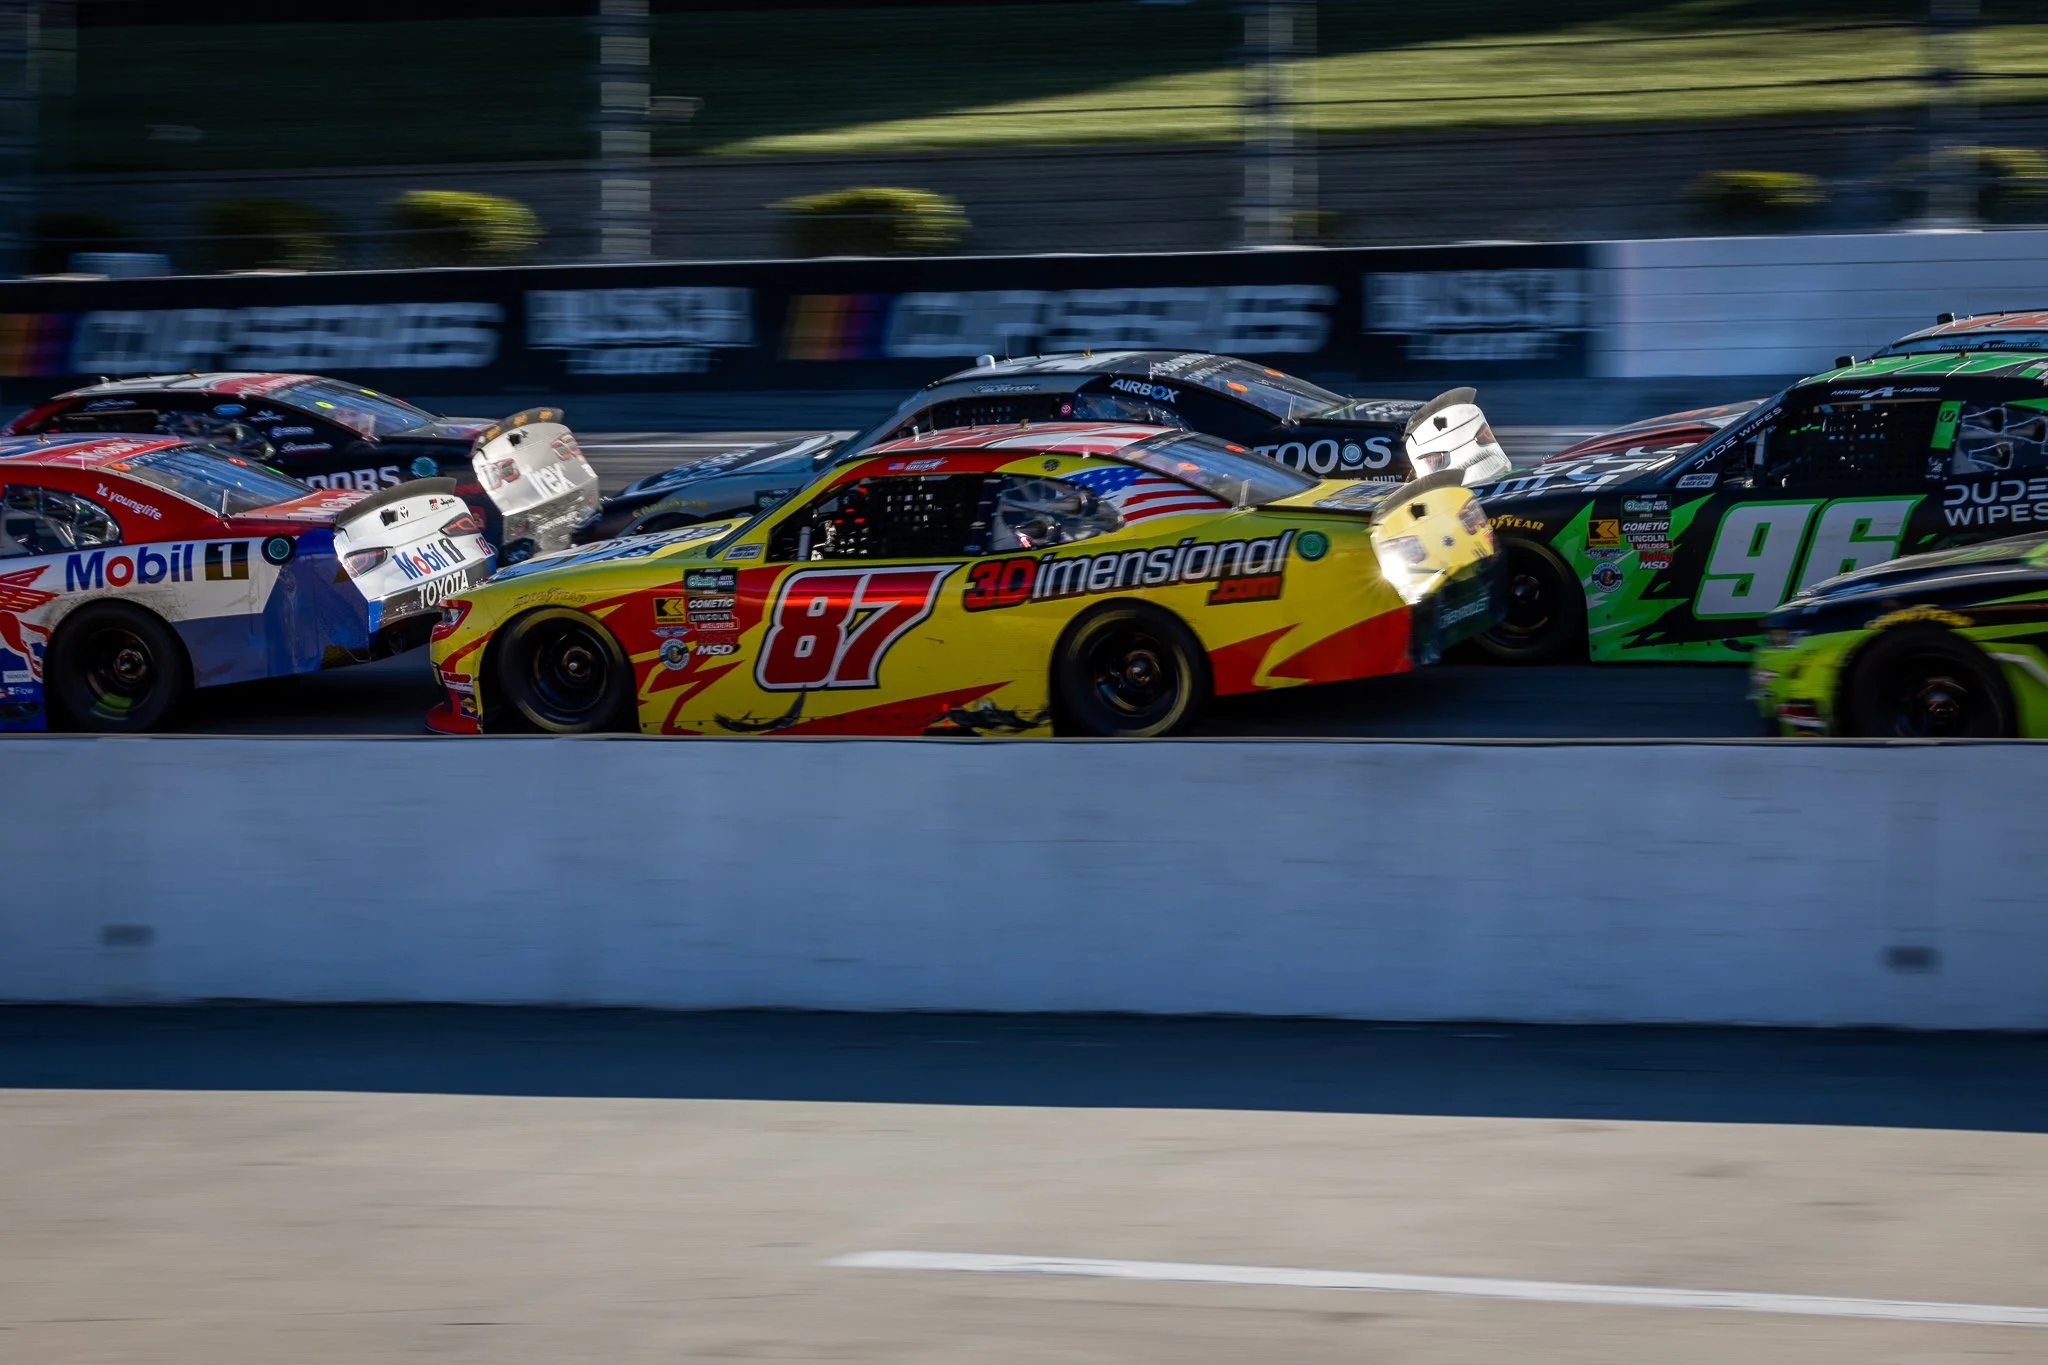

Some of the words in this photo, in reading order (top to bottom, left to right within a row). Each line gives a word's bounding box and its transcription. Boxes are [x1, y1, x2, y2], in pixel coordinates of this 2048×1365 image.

[1109, 378, 1180, 403] AIRBOX
[1694, 435, 1738, 470] DUDE
[1739, 406, 1783, 437] WIPES
[1943, 477, 2048, 506] DUDE
[109, 491, 162, 521] younglife
[1943, 502, 2048, 527] WIPES
[1622, 522, 1669, 532] COMETIC
[1627, 534, 1666, 543] LINCOLN
[475, 536, 493, 556] 19
[1692, 494, 1928, 620] 96
[66, 544, 194, 592] Mobil
[391, 543, 449, 580] Mobil
[965, 529, 1297, 611] 3Dimensional
[1640, 561, 1669, 569] MSD
[418, 569, 469, 609] TOYOTA
[688, 599, 734, 609] COMETIC
[690, 613, 731, 621] LINCOLN
[755, 564, 962, 691] 87
[696, 644, 734, 656] MSD
